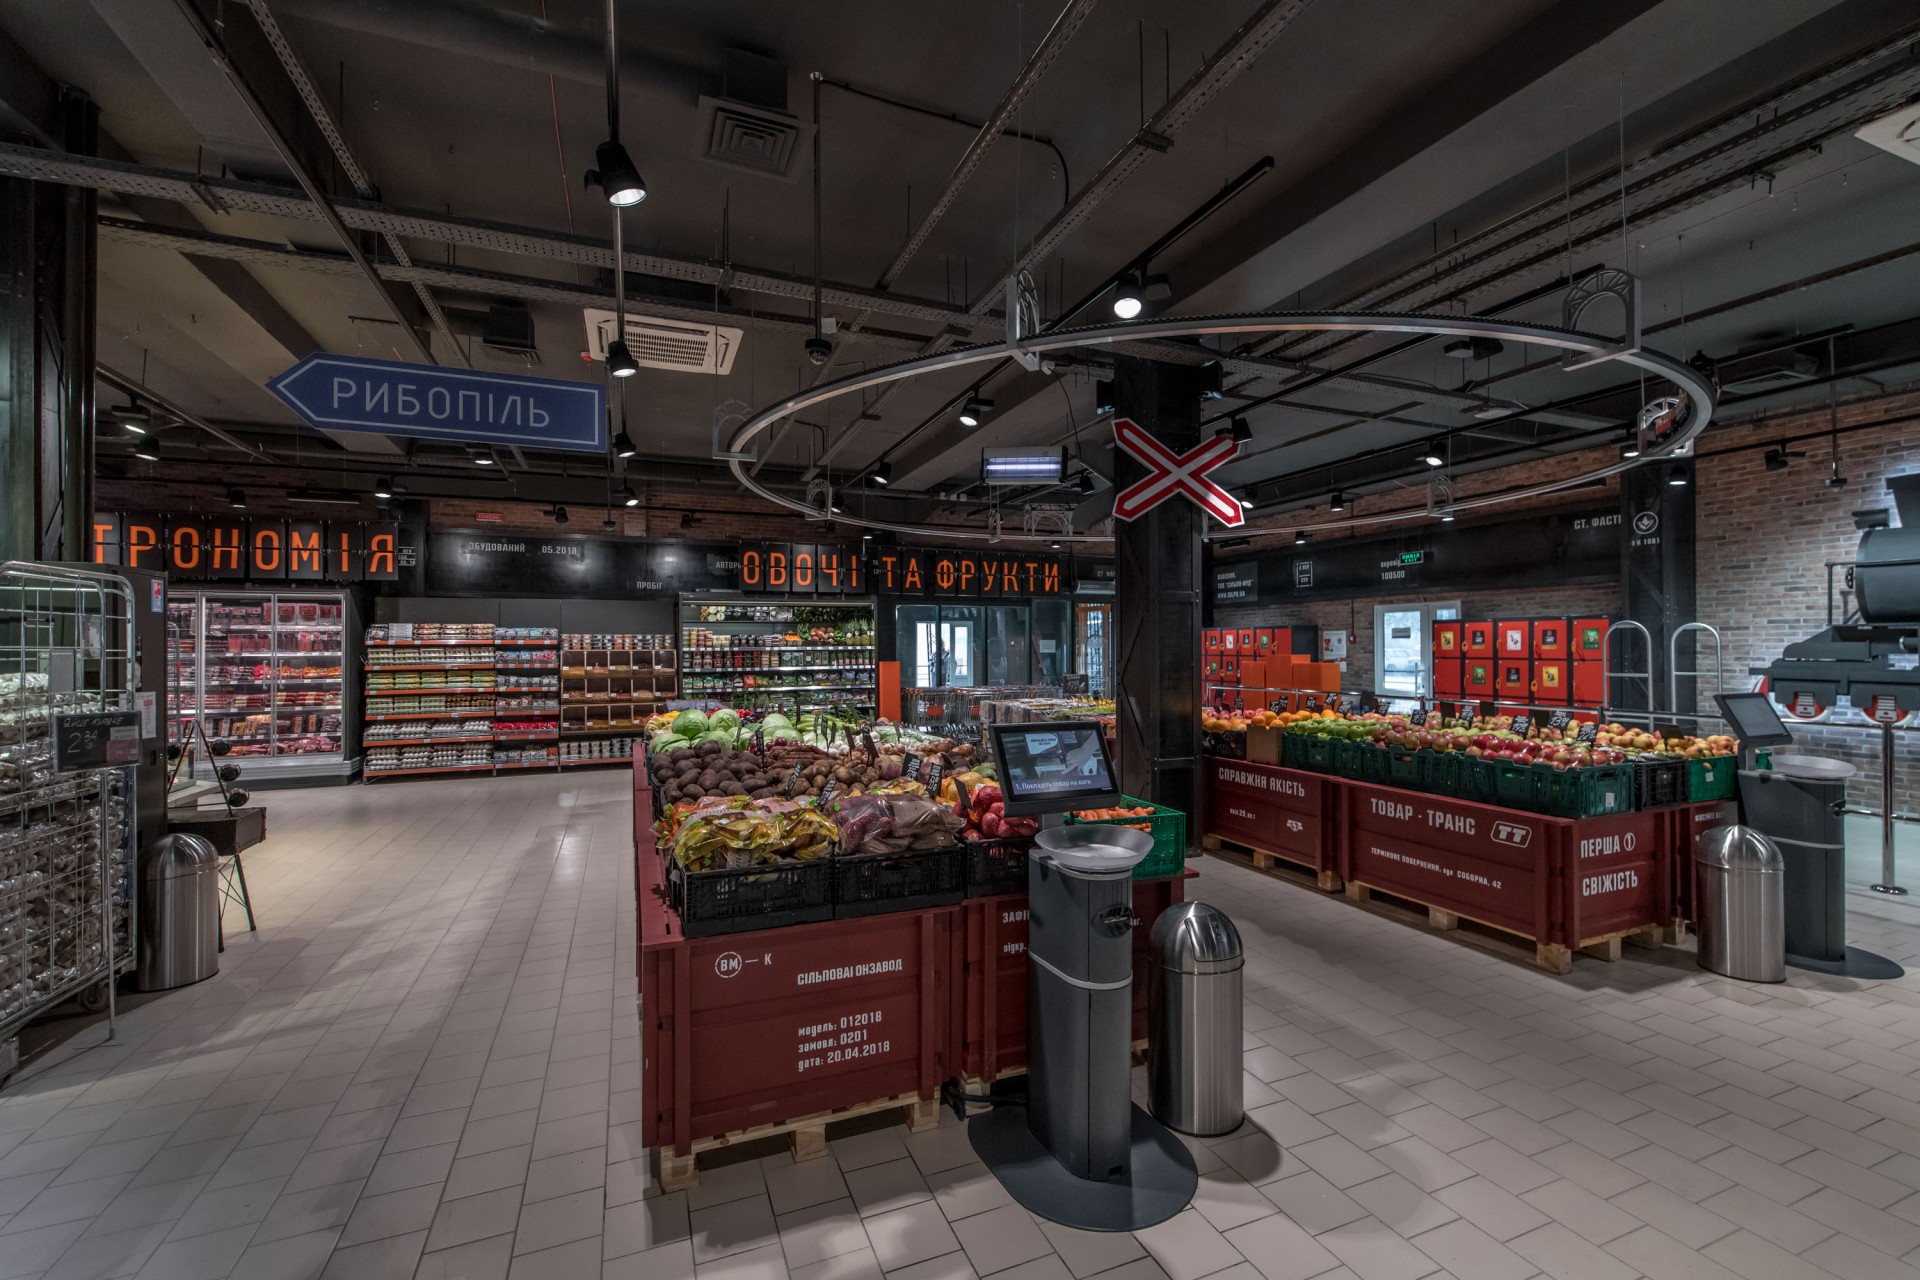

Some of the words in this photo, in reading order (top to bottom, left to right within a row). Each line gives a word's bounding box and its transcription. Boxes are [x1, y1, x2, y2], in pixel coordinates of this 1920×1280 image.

[332, 376, 550, 428] РИБОПІЛЬ
[468, 541, 526, 553] ЗБУДОВАНИЙ
[541, 544, 578, 555] 05.2018
[742, 550, 858, 587] ОВОЧІ
[881, 557, 922, 589] ТА
[935, 559, 1060, 593] ФРУКТИ
[1381, 570, 1406, 580] 100500
[636, 581, 663, 590] ПРОБІГ
[1022, 781, 1052, 790] Покладіть
[1218, 767, 1267, 789] СПРАВЖНЯ
[1269, 777, 1305, 797] ЯКІСТЬ
[1370, 797, 1414, 821] ТОВАР
[1427, 809, 1476, 836] ТРАНС
[1580, 834, 1621, 859] ПЕРША
[1491, 880, 1502, 889] 42
[1582, 870, 1638, 897] СВІЖІСТЬ
[798, 1021, 837, 1037] модель:
[840, 1010, 883, 1030] 012018
[798, 1038, 837, 1053] замовл:
[840, 1029, 868, 1046] 0201
[798, 1056, 824, 1072] дата:
[827, 1041, 890, 1064] 20.04.2018
